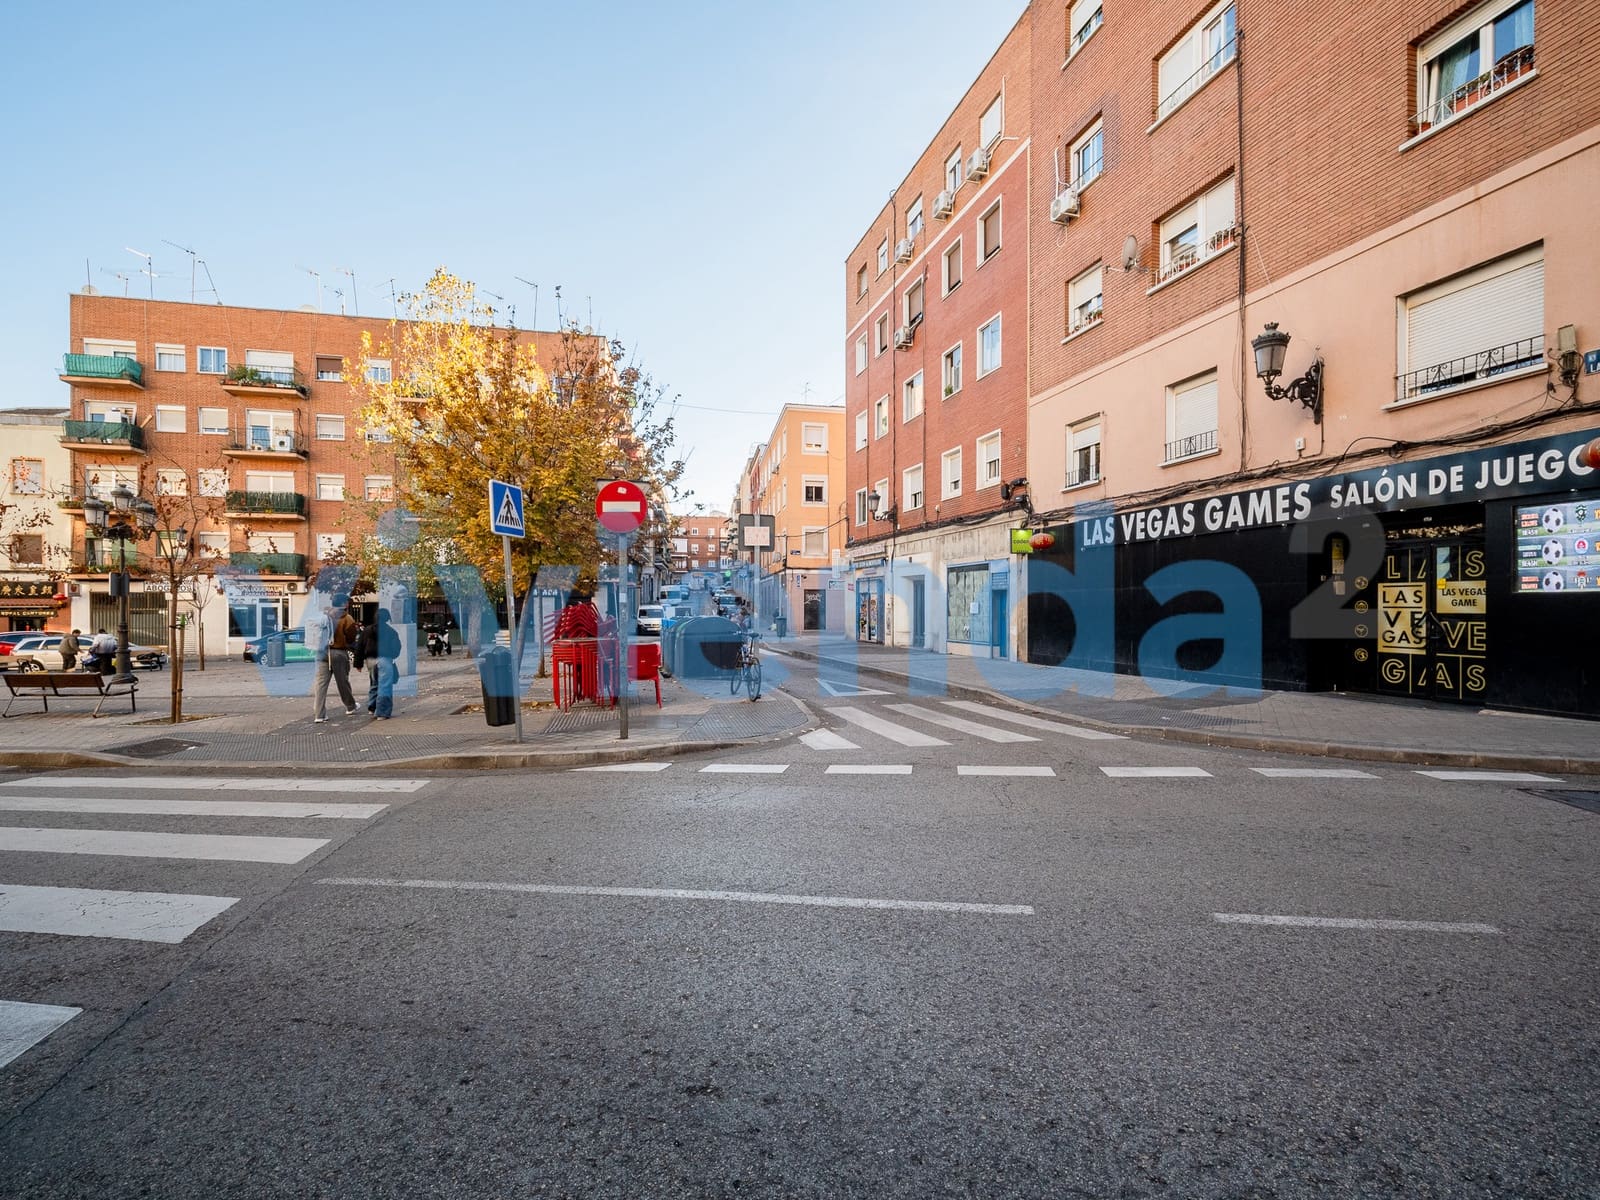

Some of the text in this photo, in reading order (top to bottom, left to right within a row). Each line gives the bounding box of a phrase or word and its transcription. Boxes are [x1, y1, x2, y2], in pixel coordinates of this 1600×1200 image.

[1330, 468, 1417, 509] SALÓN
[1428, 465, 1464, 495] DE
[1083, 483, 1312, 546] LAS VEGAS GAMES
[1382, 590, 1423, 604] LAS
[1442, 588, 1487, 596] LAS VEGAS
[1451, 598, 1478, 607] GAME
[1382, 631, 1424, 644] GAS
[1440, 621, 1487, 651] VE
